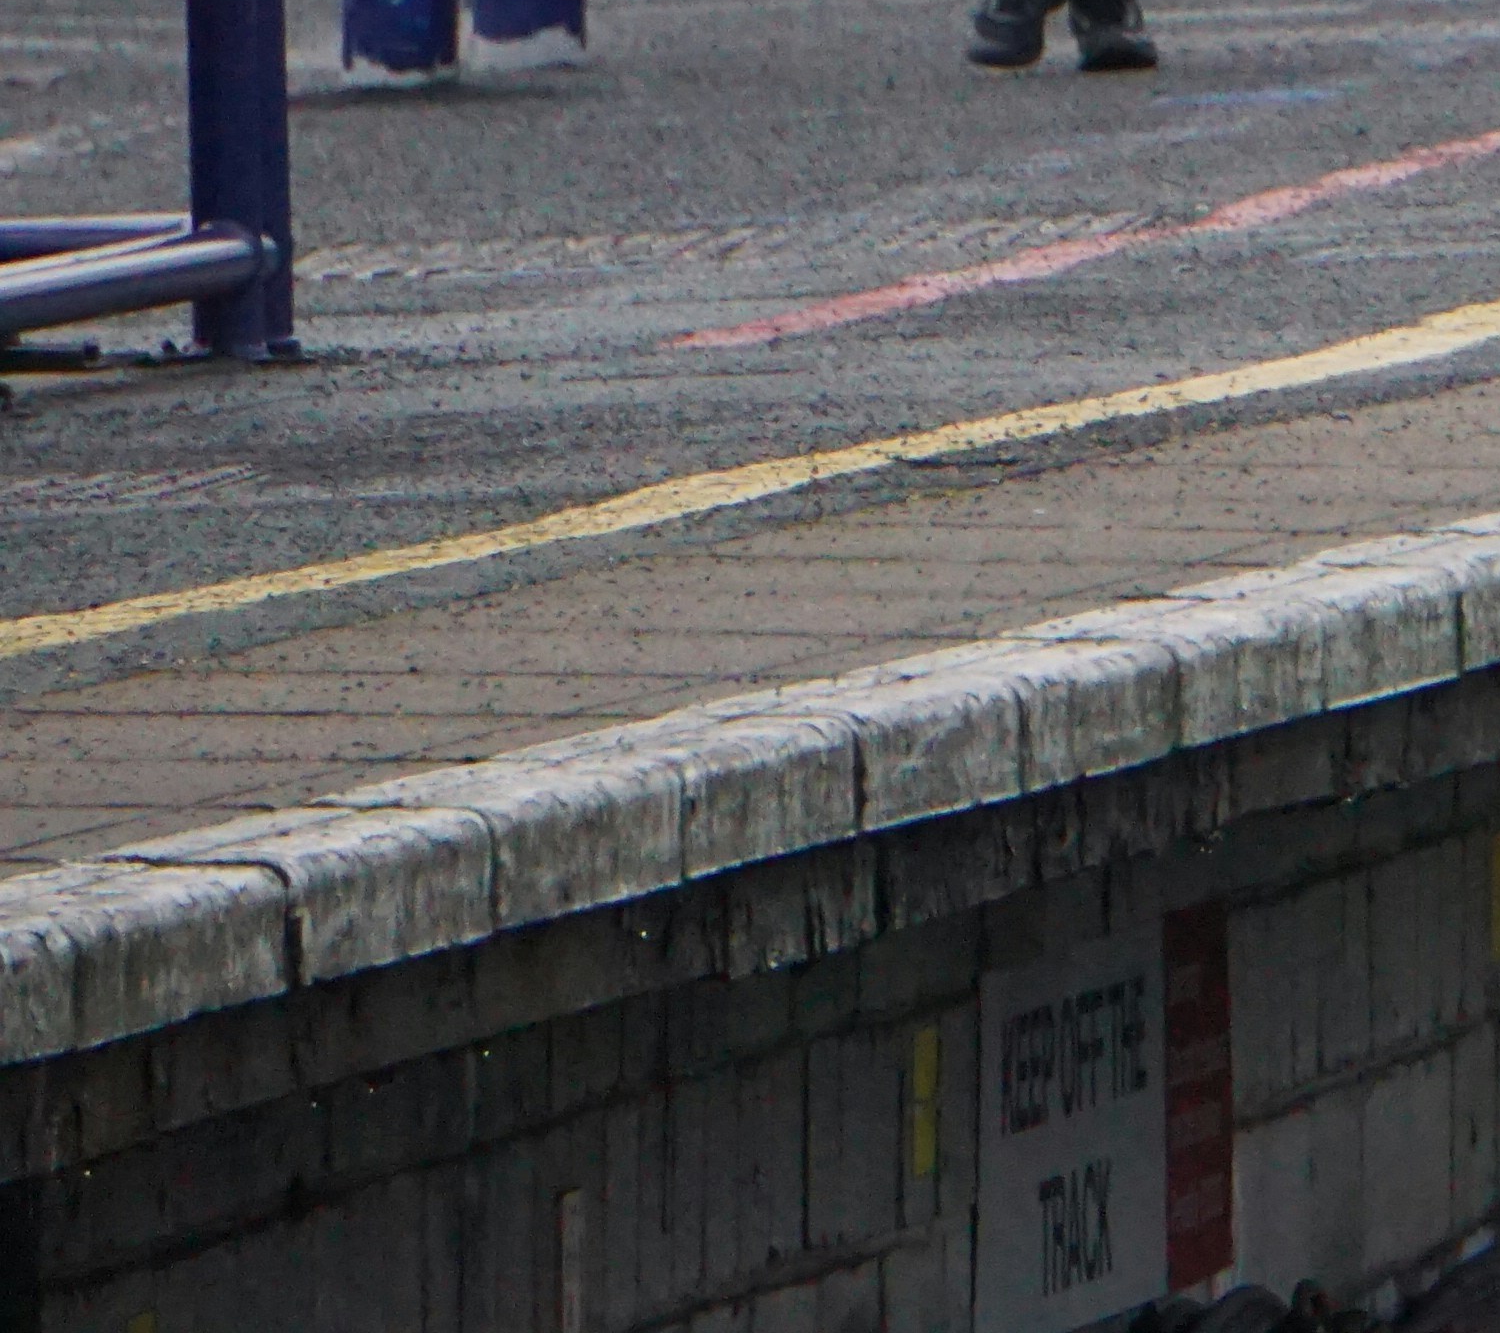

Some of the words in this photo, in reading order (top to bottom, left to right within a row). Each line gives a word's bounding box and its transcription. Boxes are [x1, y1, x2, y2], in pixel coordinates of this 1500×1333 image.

[1001, 1003, 1054, 1139] KEEP
[1059, 989, 1105, 1119] OFF
[1105, 973, 1148, 1101] THE
[1038, 1156, 1115, 1298] TRACK
